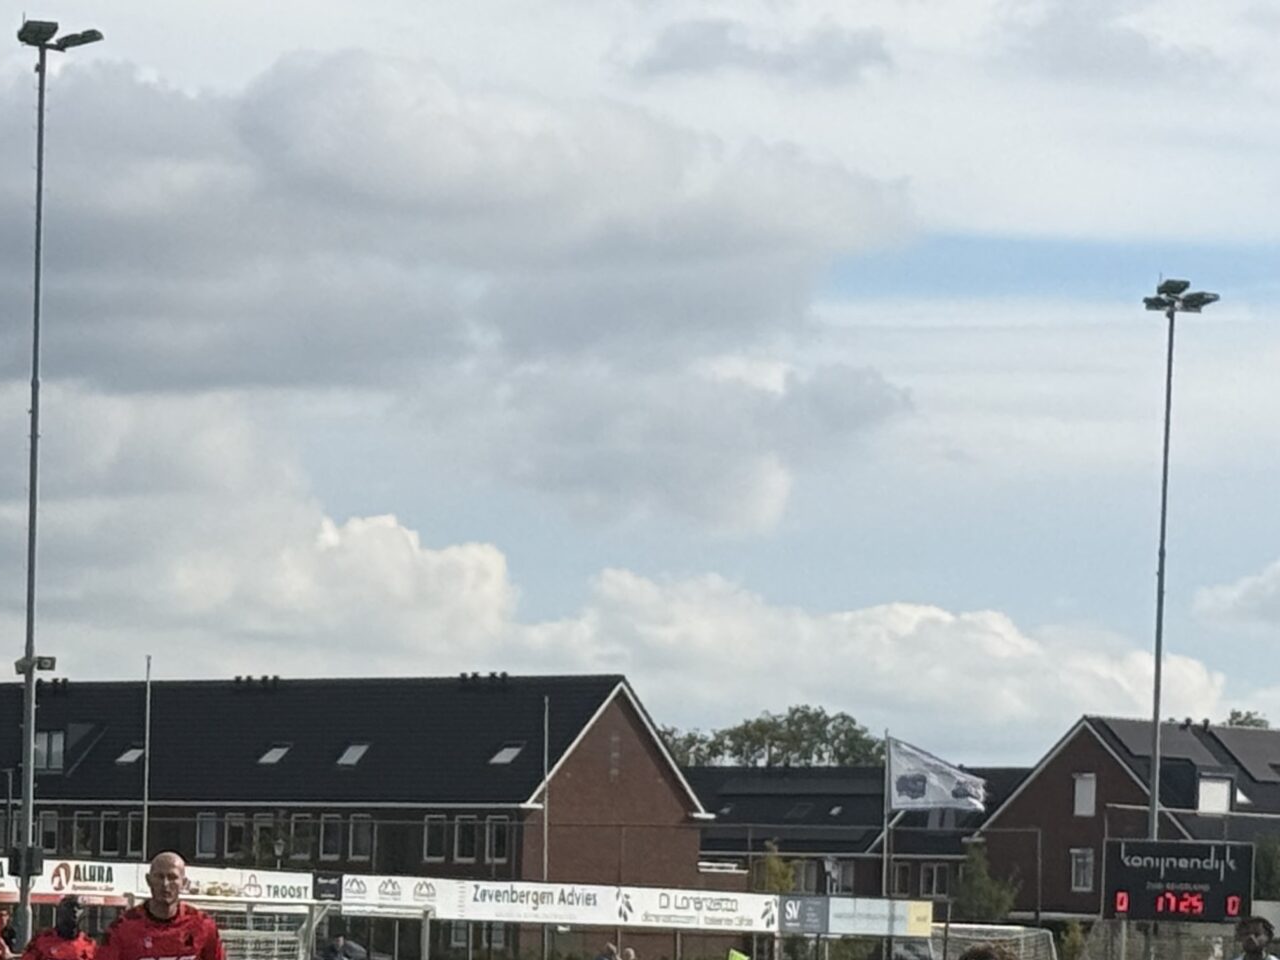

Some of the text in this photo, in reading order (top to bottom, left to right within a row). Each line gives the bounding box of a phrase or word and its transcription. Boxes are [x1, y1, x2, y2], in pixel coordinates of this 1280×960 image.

[266, 885, 309, 900] TROOST
[558, 887, 597, 906] Advies
[785, 901, 800, 920] SV
